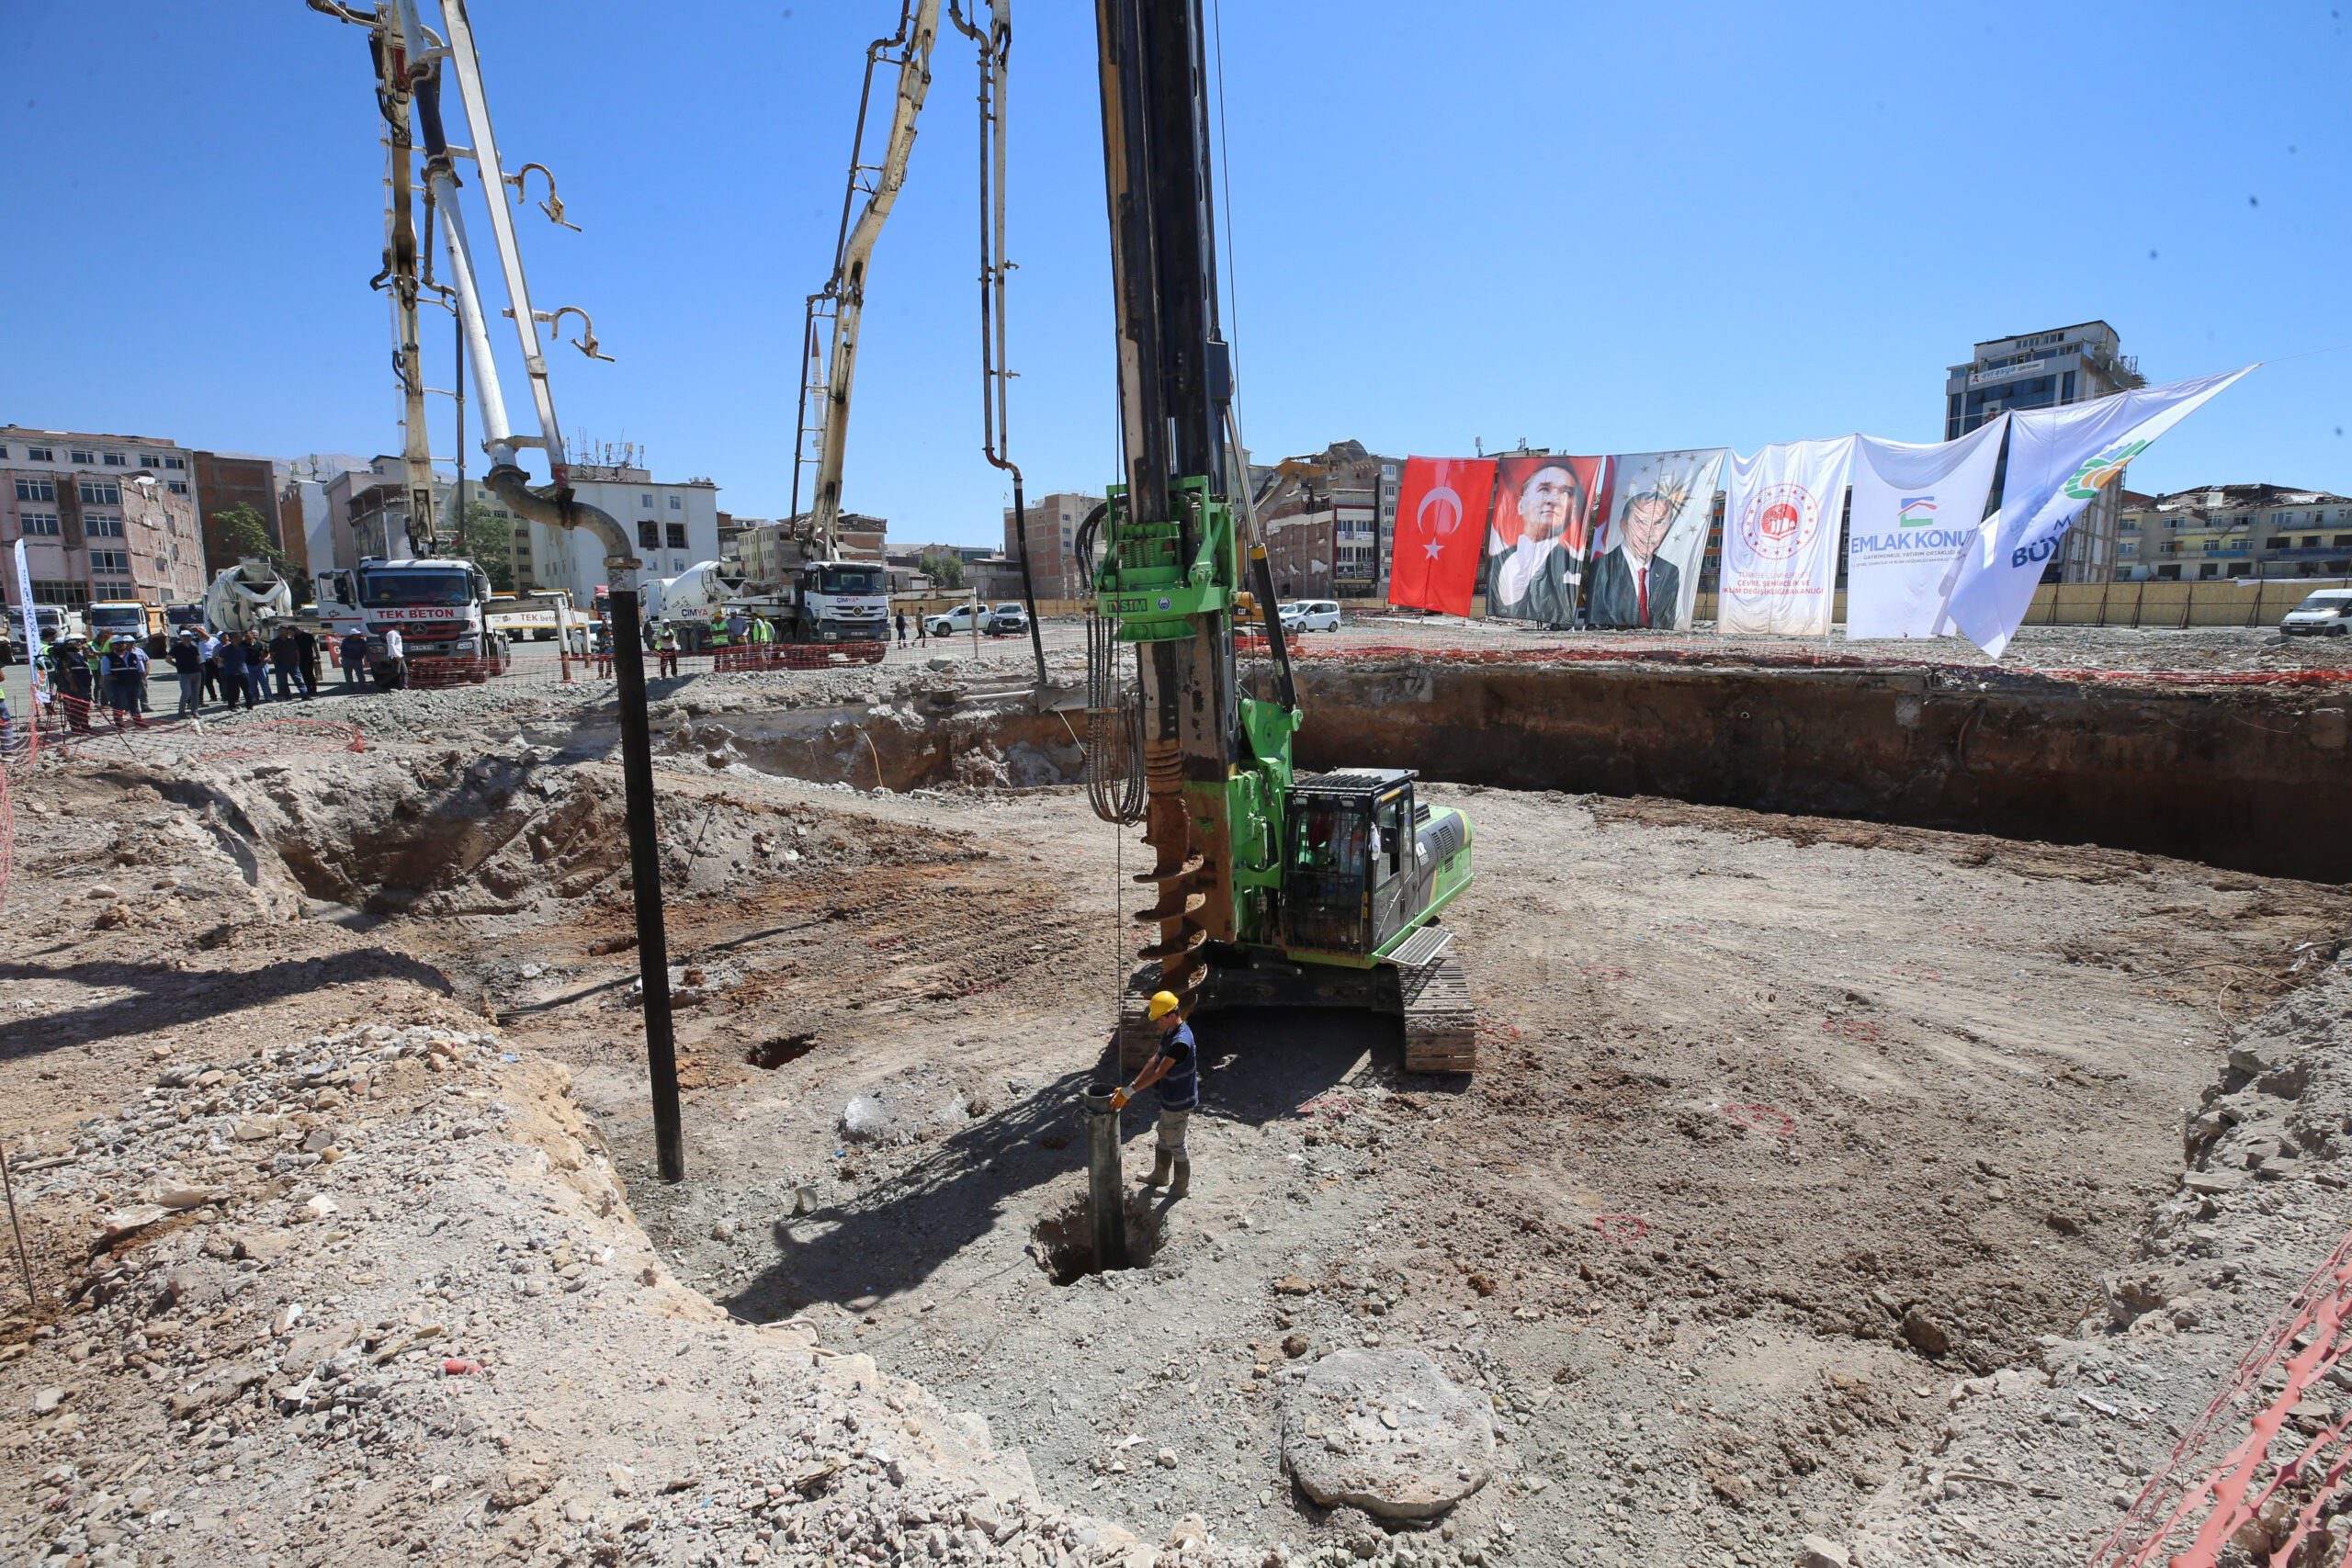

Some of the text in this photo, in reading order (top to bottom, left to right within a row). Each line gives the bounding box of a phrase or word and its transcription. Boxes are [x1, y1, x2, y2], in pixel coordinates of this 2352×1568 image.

[1851, 532, 1912, 554] EMLAK
[378, 608, 454, 619] TEK BETON
[520, 614, 538, 622] TEK
